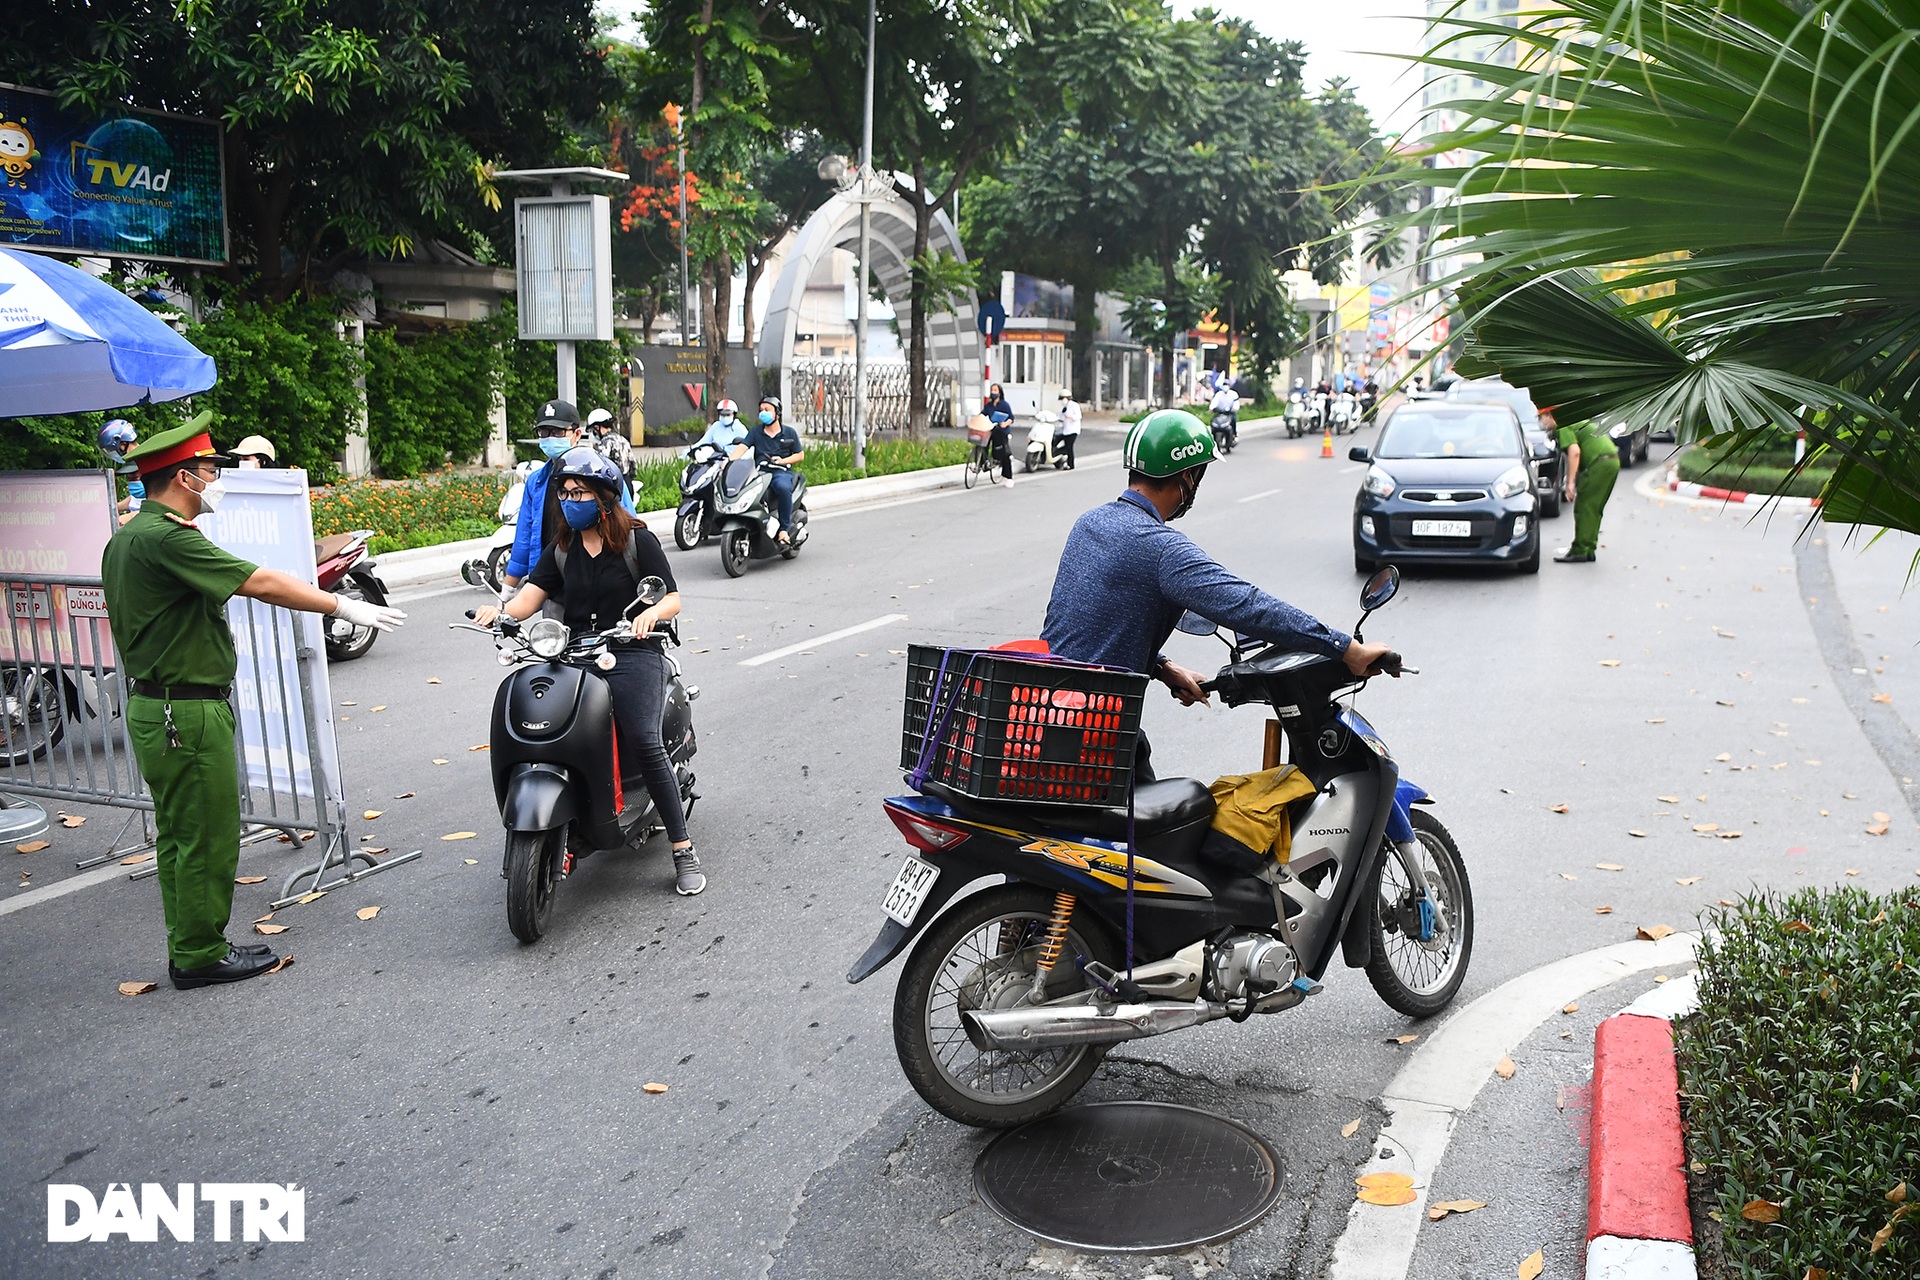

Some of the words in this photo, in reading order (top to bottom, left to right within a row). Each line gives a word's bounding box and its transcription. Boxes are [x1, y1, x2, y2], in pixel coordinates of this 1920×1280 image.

[87, 158, 171, 192] TVAd
[73, 189, 121, 204] Connecting
[154, 199, 173, 208] Trust
[1171, 439, 1204, 461] Grab
[15, 602, 40, 613] STP
[1309, 827, 1350, 836] HONDA
[900, 859, 933, 893] 89-K7
[885, 884, 917, 919] 2573
